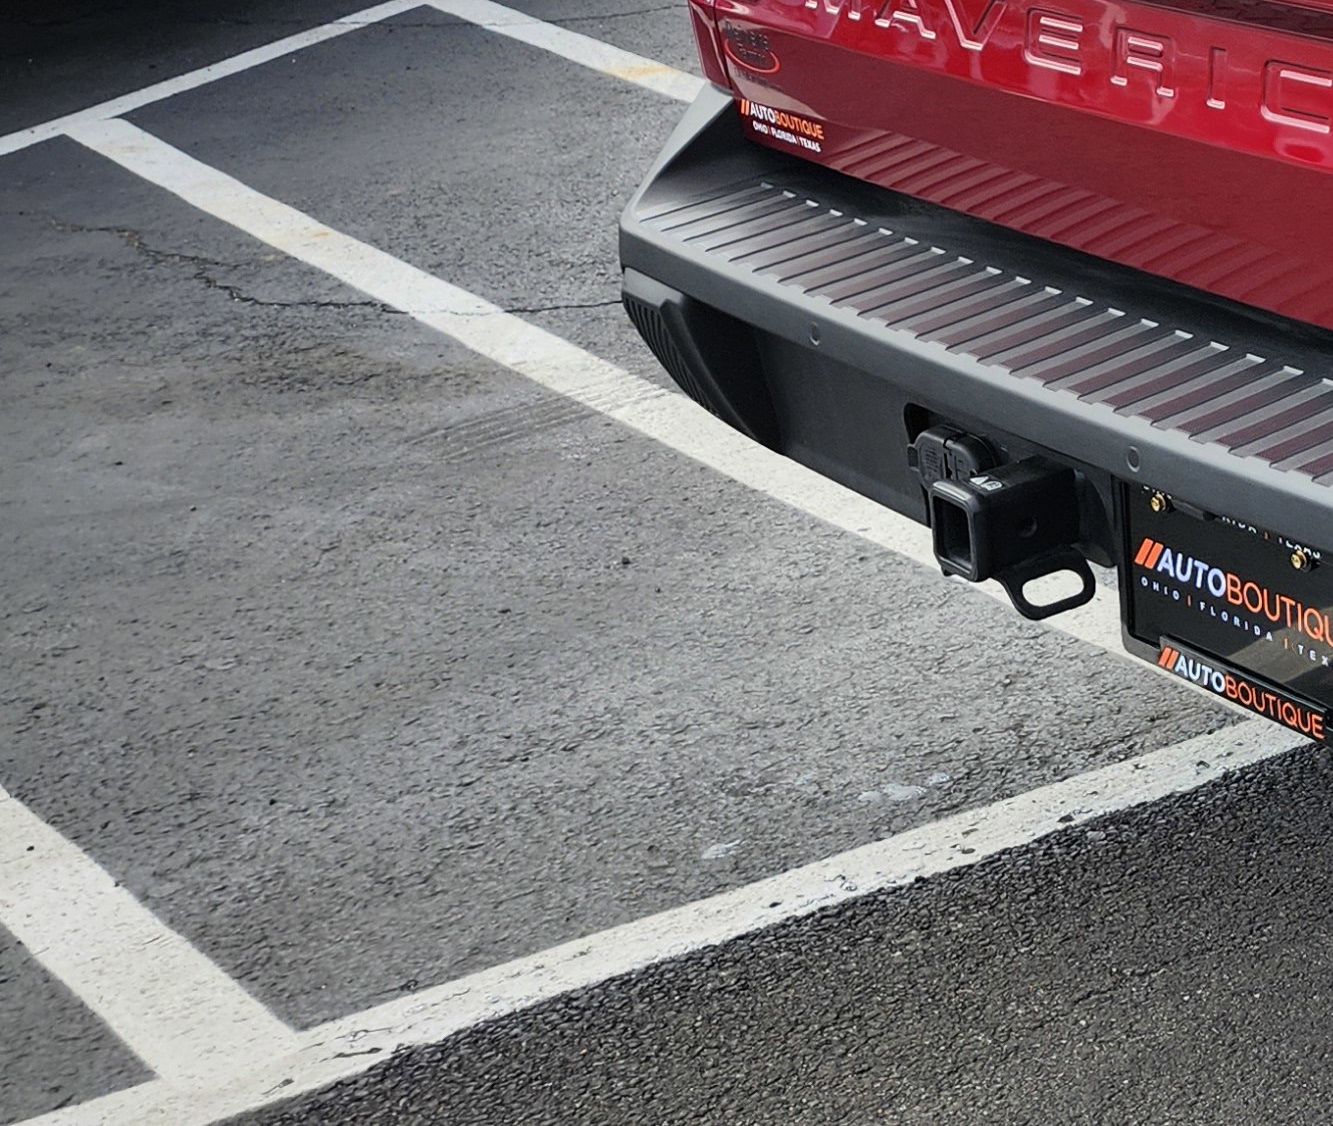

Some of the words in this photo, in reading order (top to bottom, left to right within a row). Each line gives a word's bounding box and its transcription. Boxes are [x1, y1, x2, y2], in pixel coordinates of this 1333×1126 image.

[749, 101, 825, 140] AUTOBOUTIQUE
[752, 120, 768, 135] OHIO
[770, 126, 797, 145] FLORIDA
[799, 136, 821, 153] TEXAS
[1140, 575, 1180, 602] OHIO
[1199, 601, 1273, 642] FLORIDA
[1174, 655, 1326, 740] AUTOBOUTIQUE
